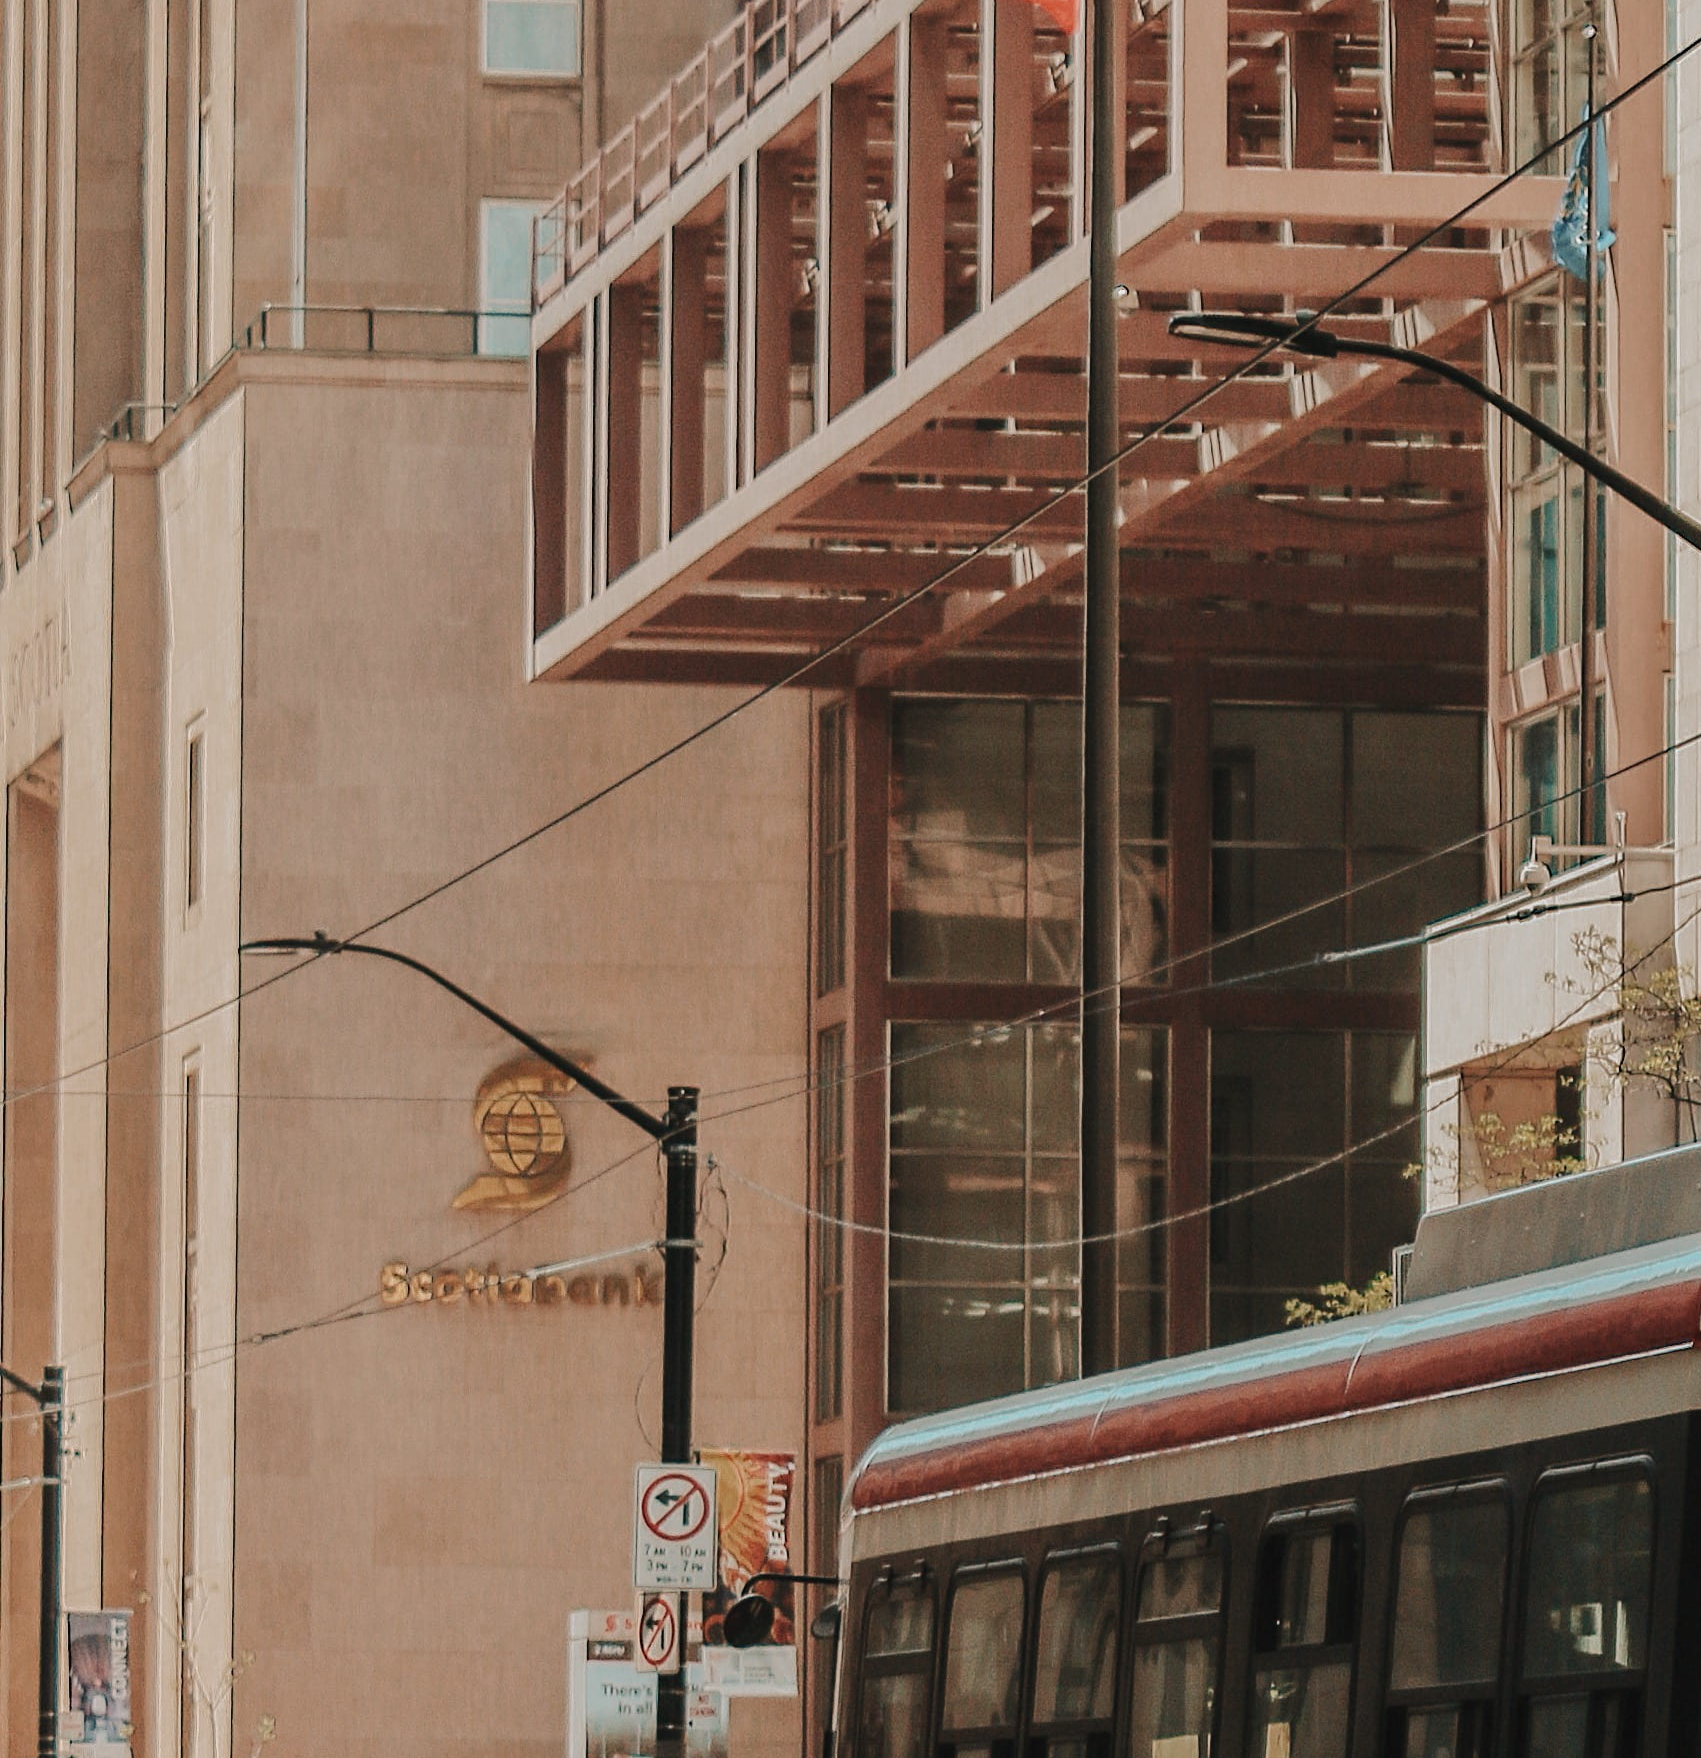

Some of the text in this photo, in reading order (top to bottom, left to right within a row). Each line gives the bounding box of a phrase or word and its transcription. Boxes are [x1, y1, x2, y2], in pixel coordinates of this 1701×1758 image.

[380, 1260, 665, 1308] Scotiabank
[765, 1461, 796, 1562] BEAUTY,
[602, 1683, 655, 1697] There's
